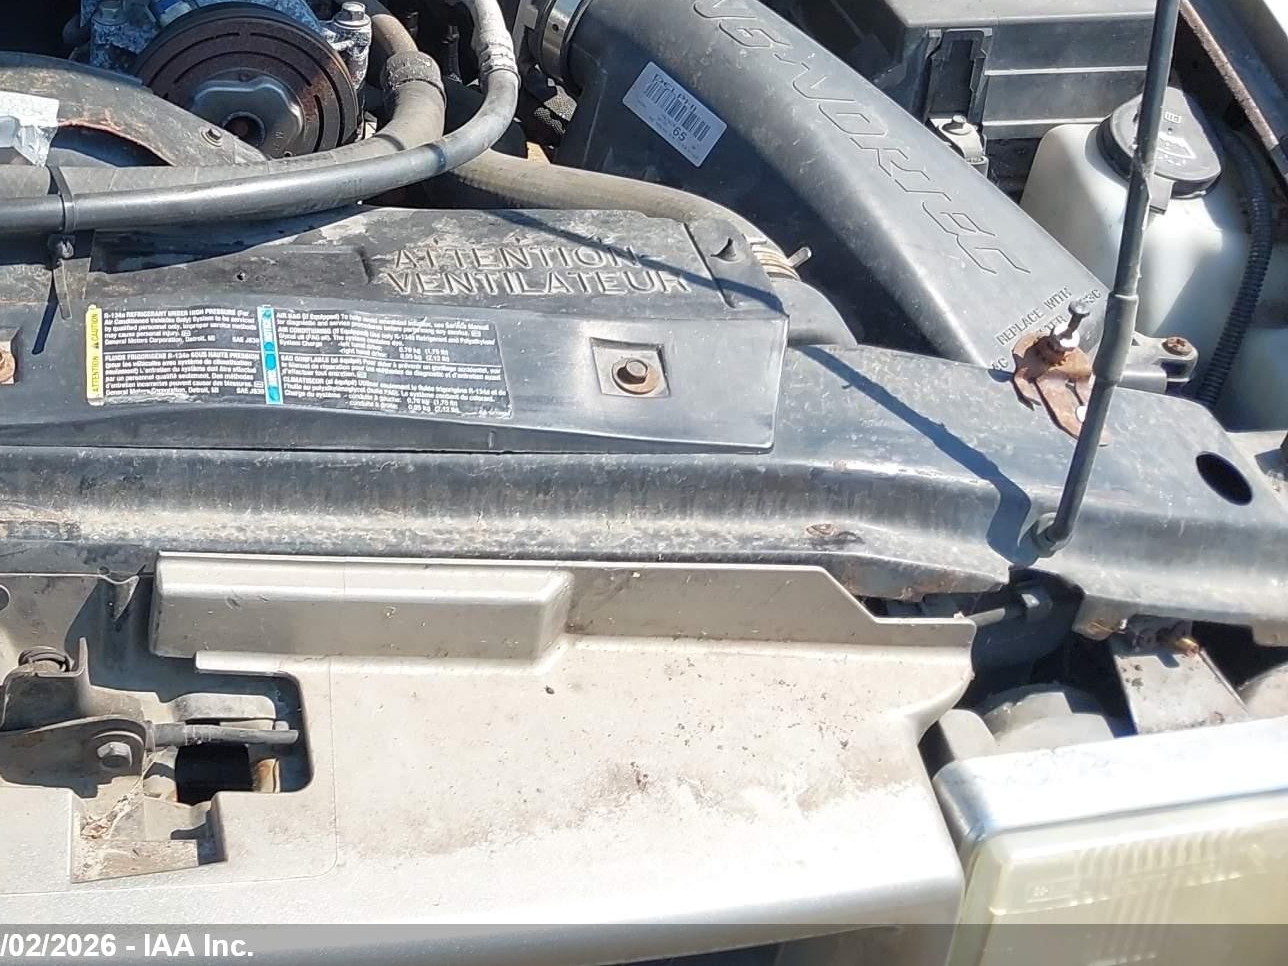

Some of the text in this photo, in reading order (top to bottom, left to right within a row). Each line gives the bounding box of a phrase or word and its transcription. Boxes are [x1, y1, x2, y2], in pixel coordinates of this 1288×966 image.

[394, 246, 642, 270] ATTENTION
[385, 271, 693, 295] VENTILATEUR
[90, 313, 100, 342] CAUTION
[996, 307, 1045, 345] REPLACE
